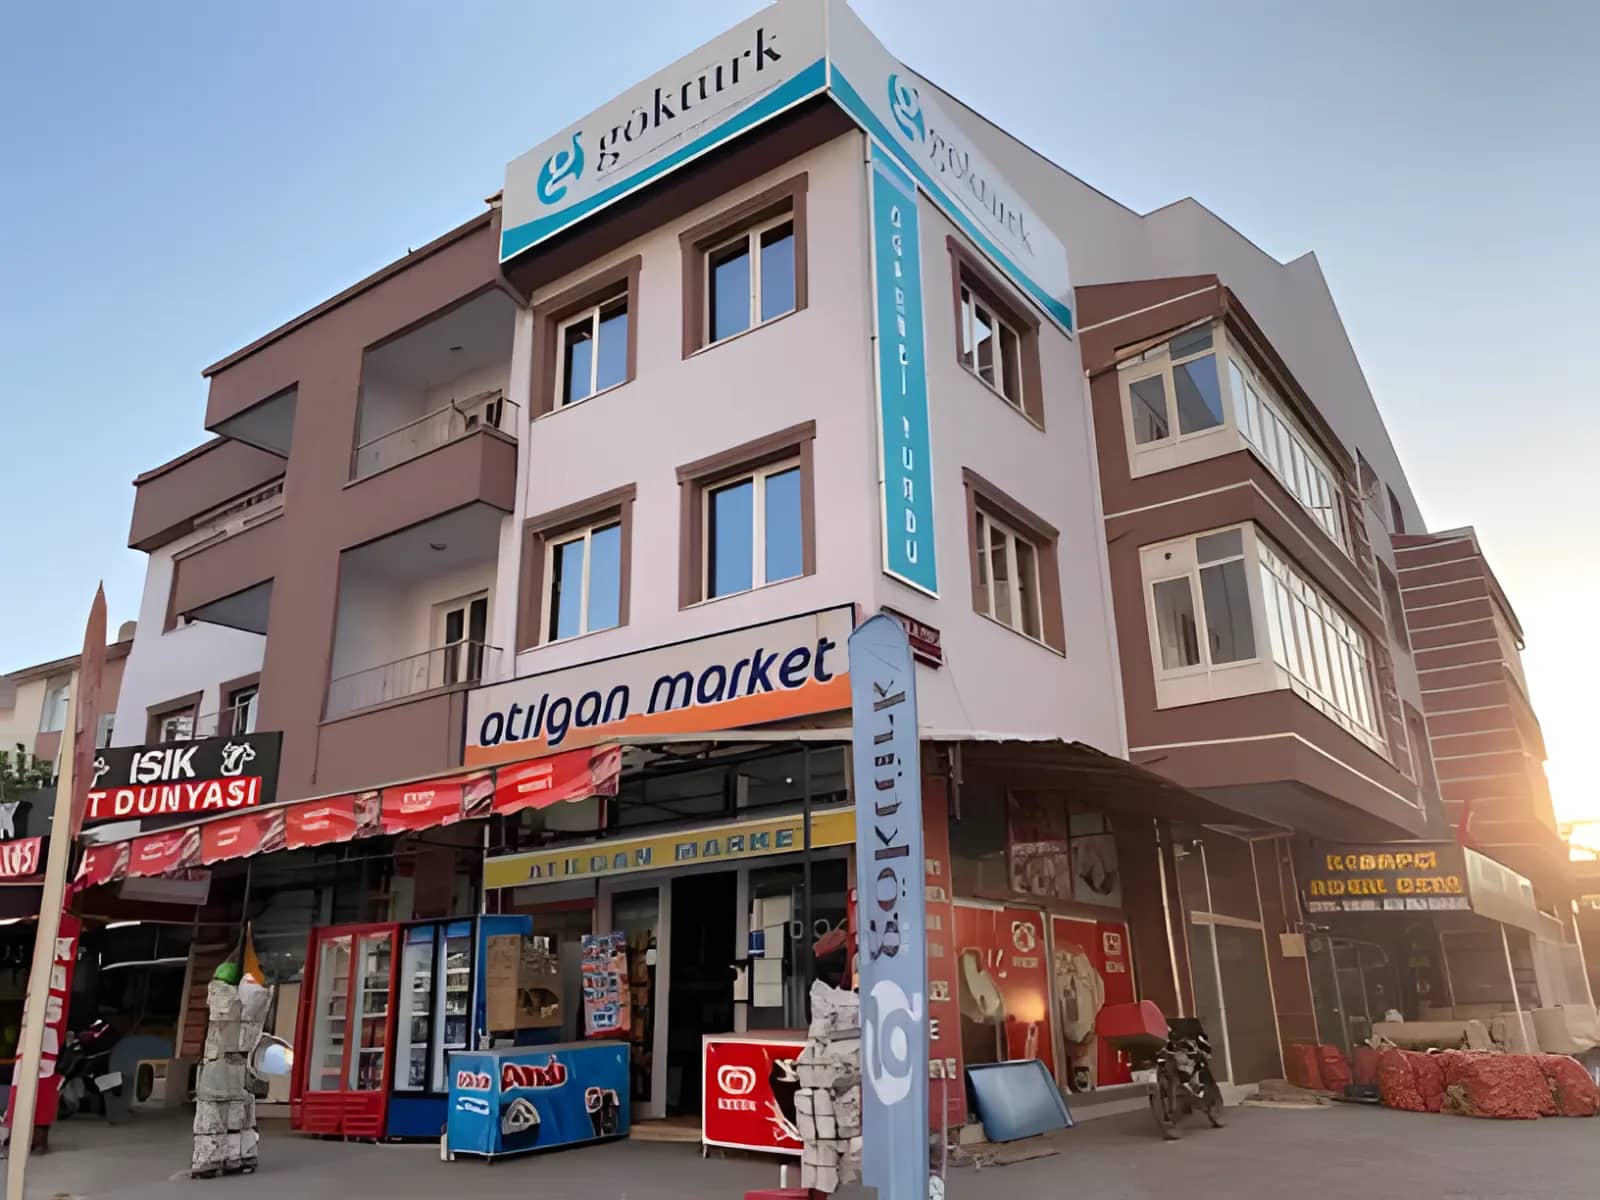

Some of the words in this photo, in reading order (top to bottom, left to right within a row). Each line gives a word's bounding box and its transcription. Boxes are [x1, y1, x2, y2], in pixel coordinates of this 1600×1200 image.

[479, 684, 629, 746] atılgan
[646, 637, 836, 714] market
[88, 791, 106, 818] T
